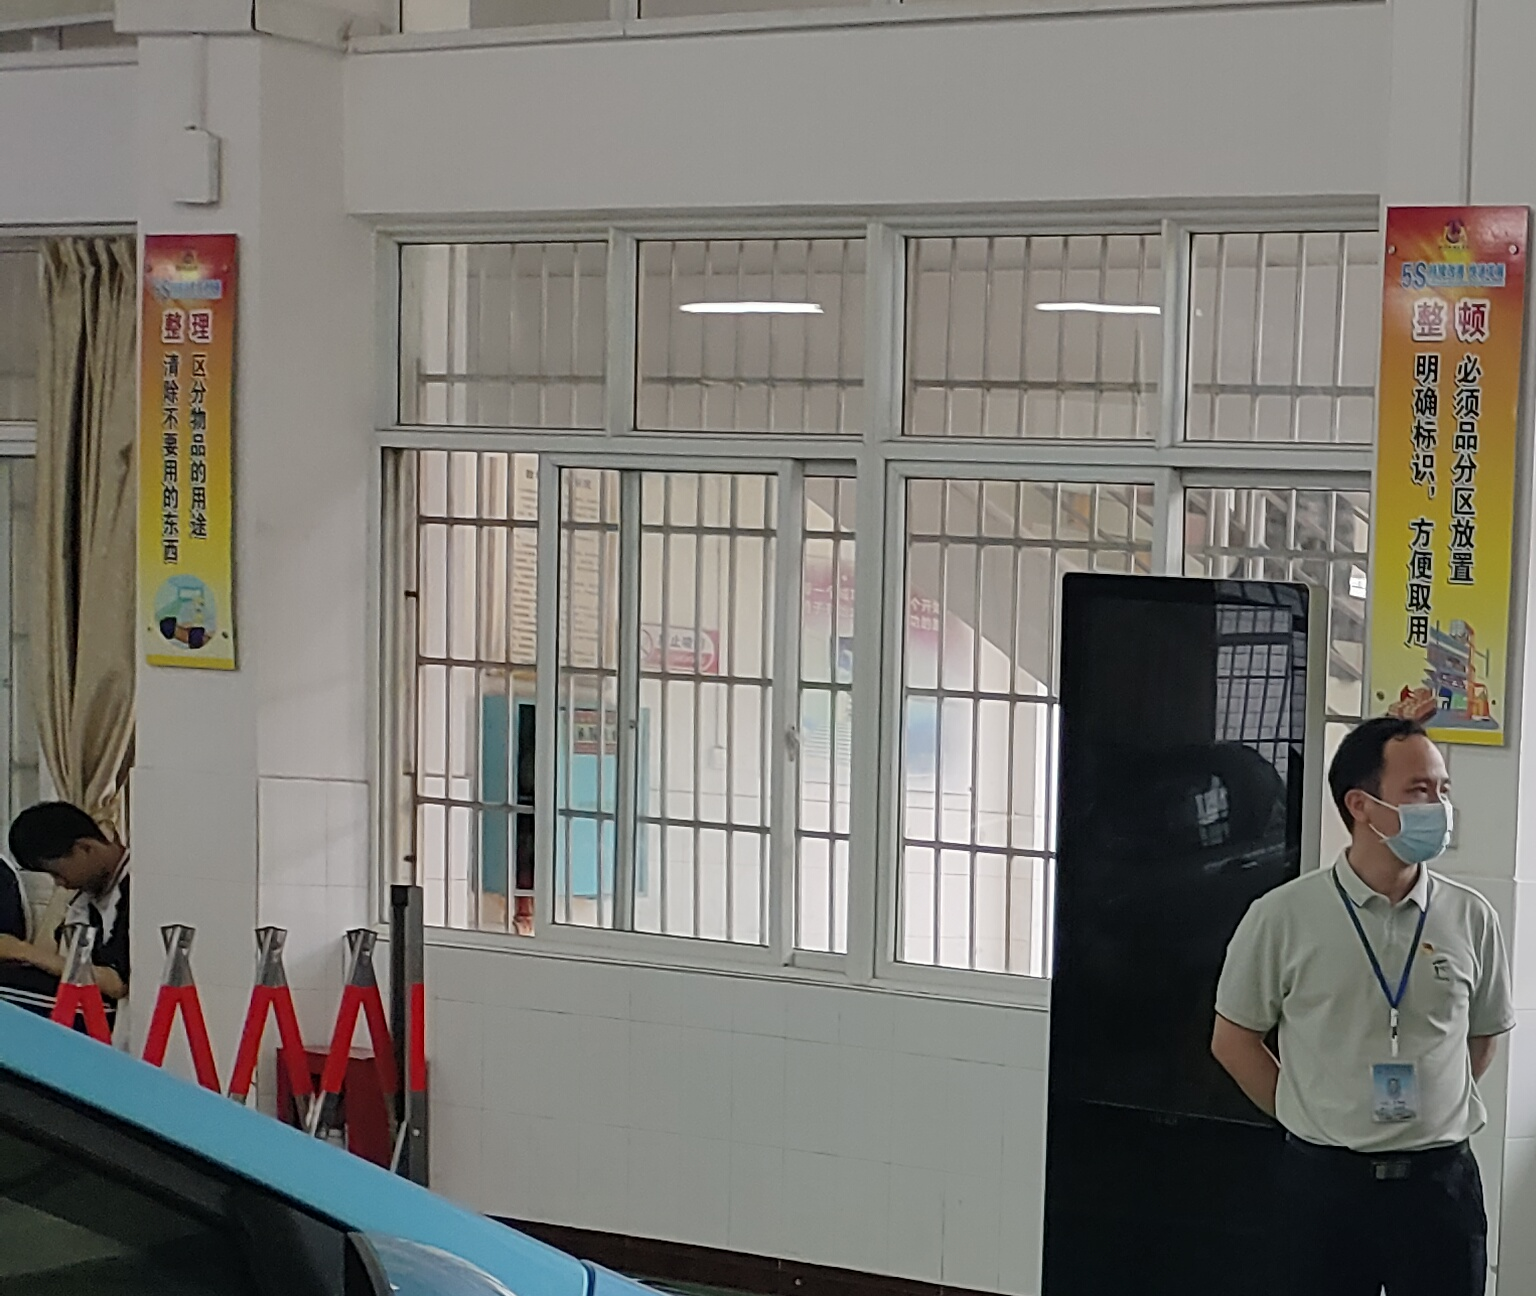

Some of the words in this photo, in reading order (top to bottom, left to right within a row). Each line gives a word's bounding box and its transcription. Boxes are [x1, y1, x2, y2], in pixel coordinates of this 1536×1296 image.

[1450, 353, 1482, 582] 必须品分区放置
